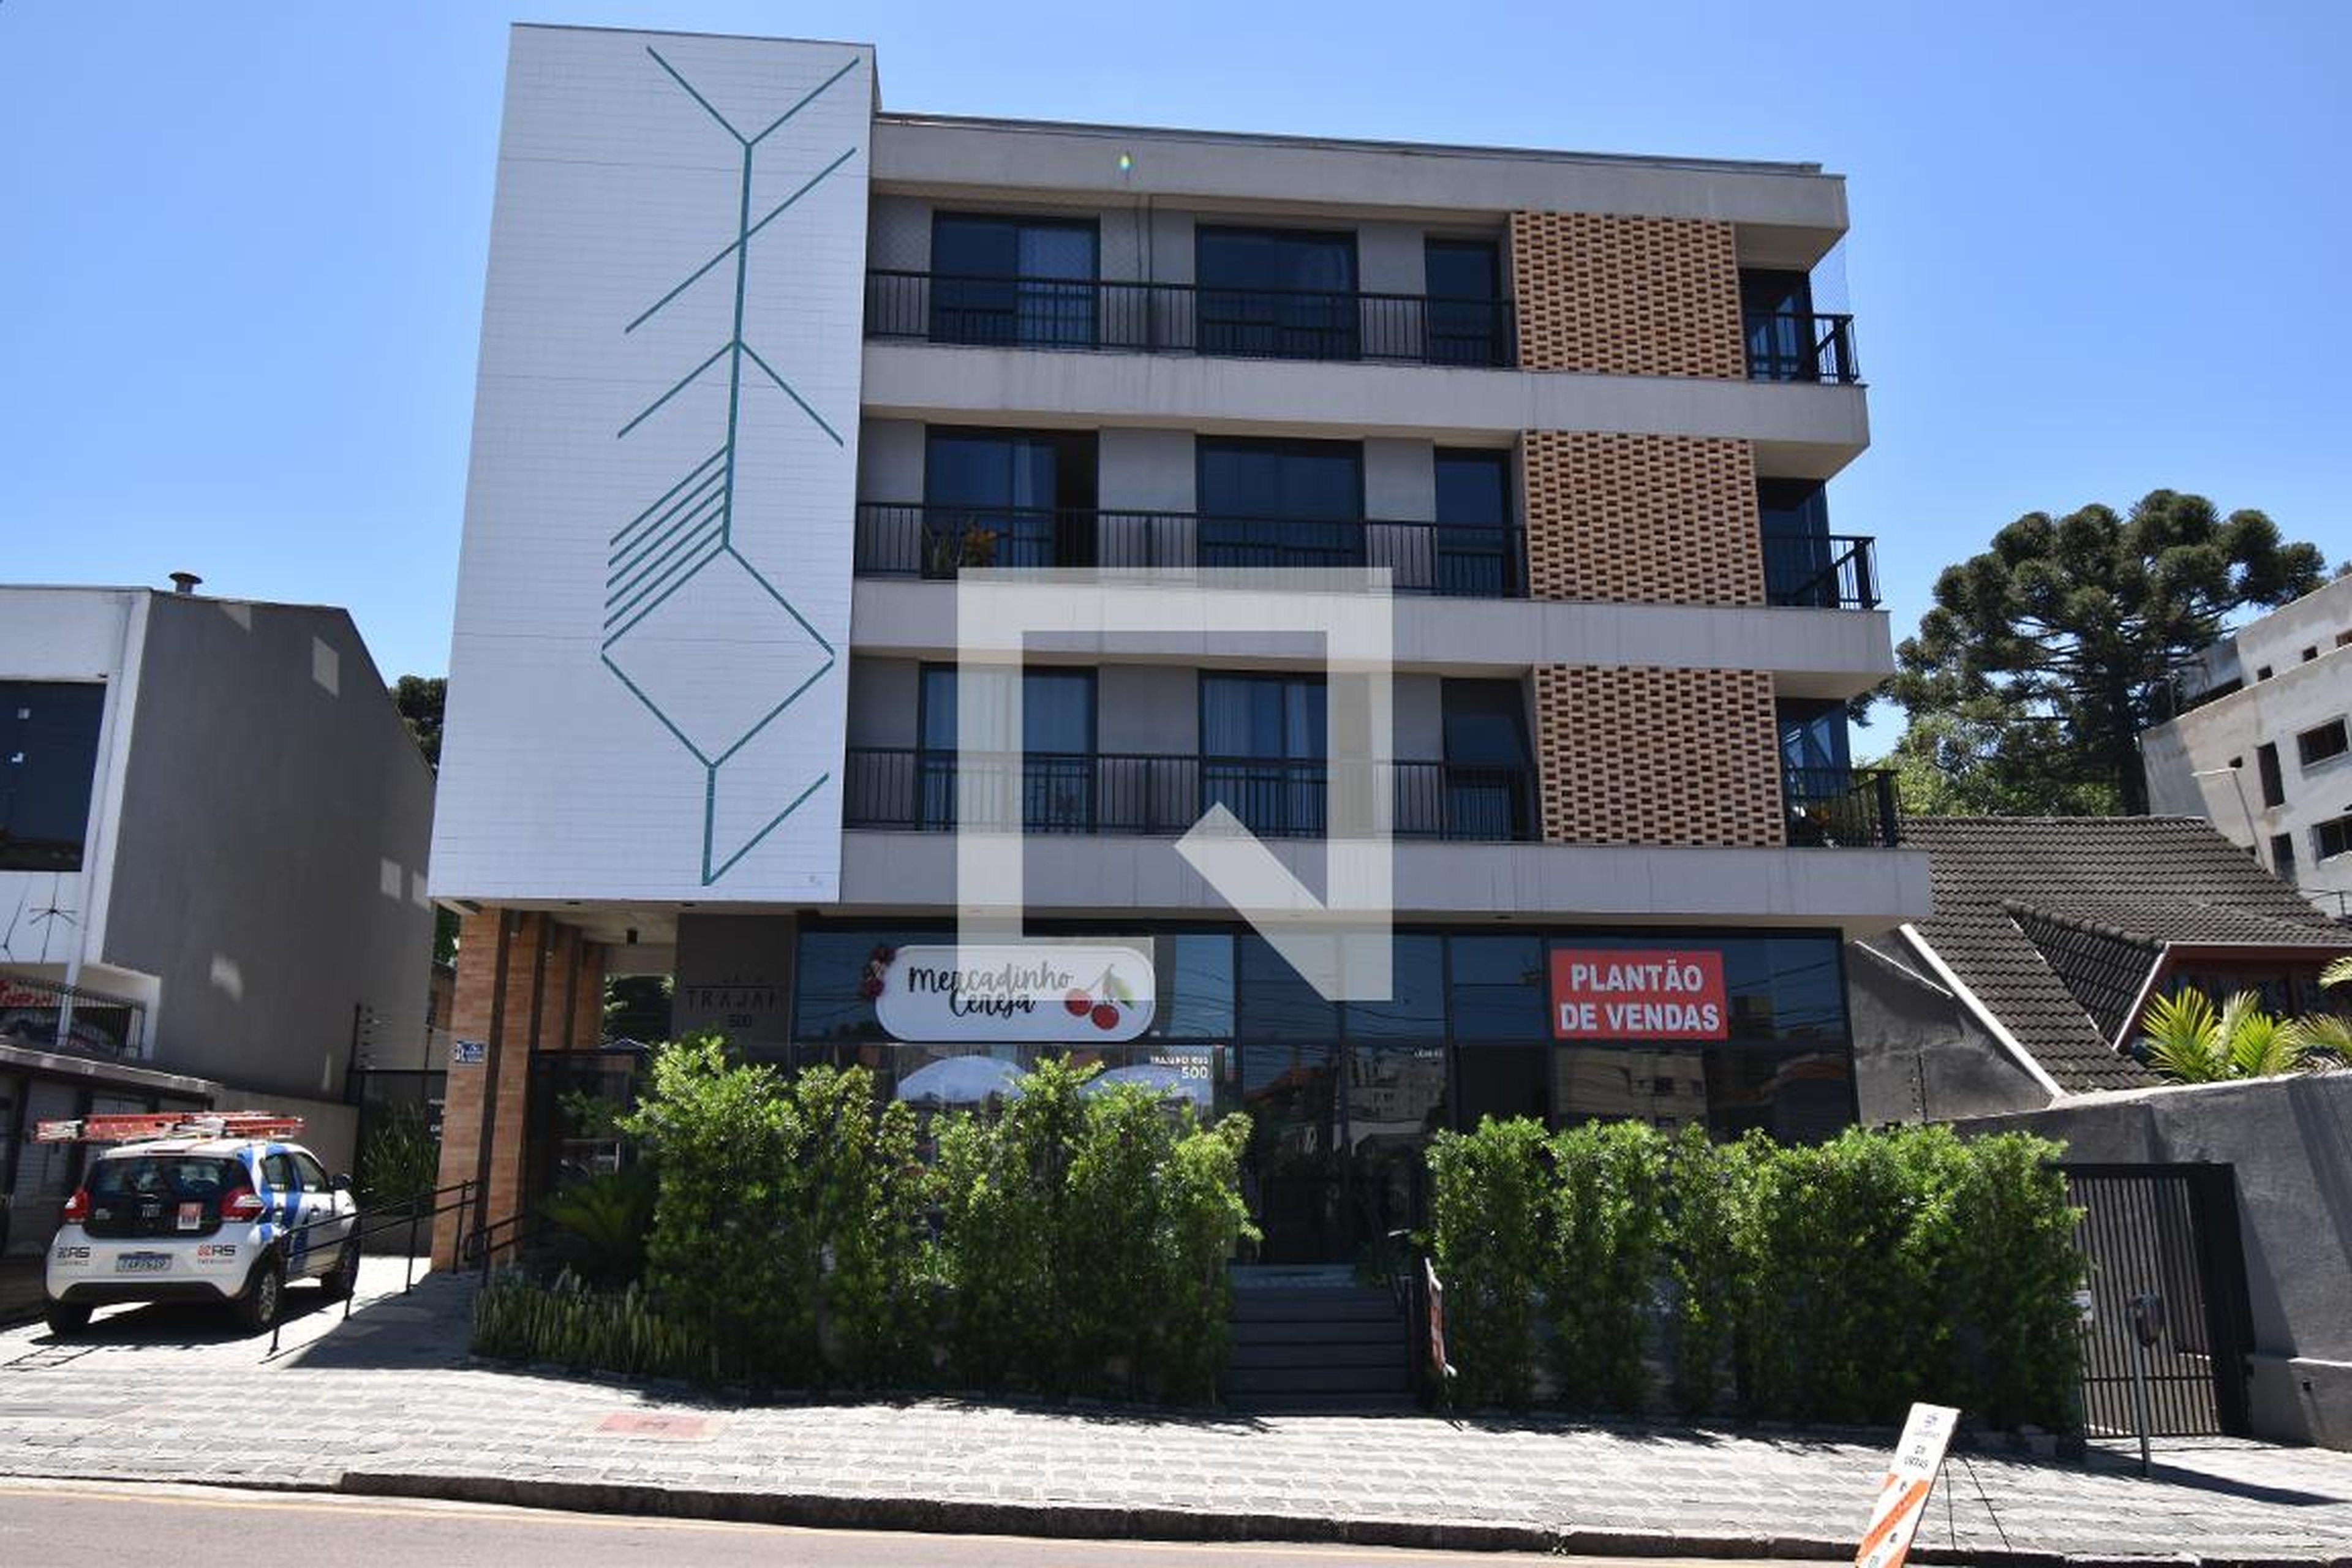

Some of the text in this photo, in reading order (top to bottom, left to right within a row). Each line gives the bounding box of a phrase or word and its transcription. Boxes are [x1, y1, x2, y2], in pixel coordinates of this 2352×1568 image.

[909, 961, 1074, 995] Mercadinho
[1570, 959, 1703, 992] PLANTÃO
[1560, 1003, 1720, 1031] DE VENDAS
[1182, 1065, 1208, 1079] 500
